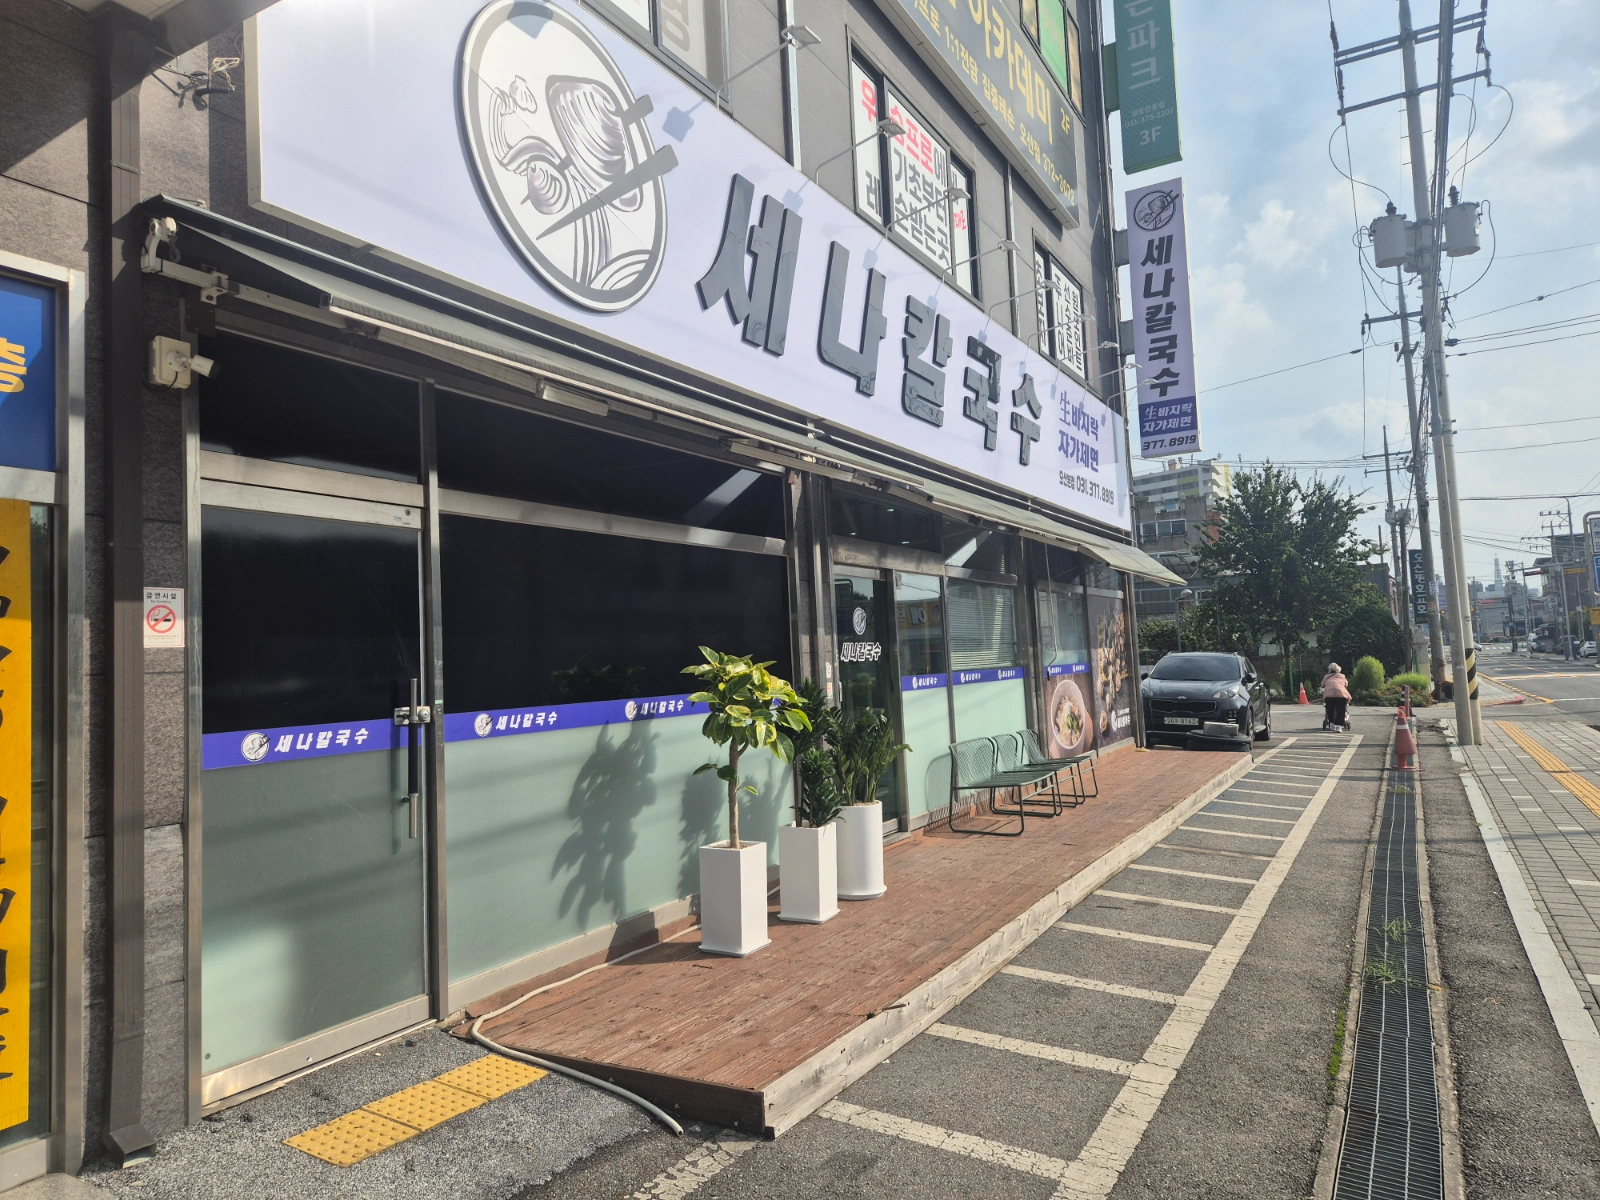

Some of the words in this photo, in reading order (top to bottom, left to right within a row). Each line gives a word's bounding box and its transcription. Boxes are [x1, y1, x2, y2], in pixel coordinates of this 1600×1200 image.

[982, 73, 1016, 131] 집중레슨
[1020, 123, 1041, 164] 오산점
[1060, 108, 1071, 135] 2F
[1125, 107, 1174, 128] 031-375-2207
[1140, 126, 1162, 146] 3F
[694, 172, 1042, 466] 세나칼국수
[1140, 234, 1181, 397] 세나칼국수
[1059, 390, 1099, 441] 生바지락
[1144, 401, 1194, 420] 生바지락
[1142, 416, 1192, 433] 자가제면
[1058, 429, 1099, 473] 자가제면
[1142, 434, 1198, 451] 377.8919
[841, 642, 881, 662] 세나칼국수
[640, 700, 684, 715] 세나칼국수
[495, 711, 558, 730] 세나칼국수
[274, 728, 369, 753] 세나칼국수
